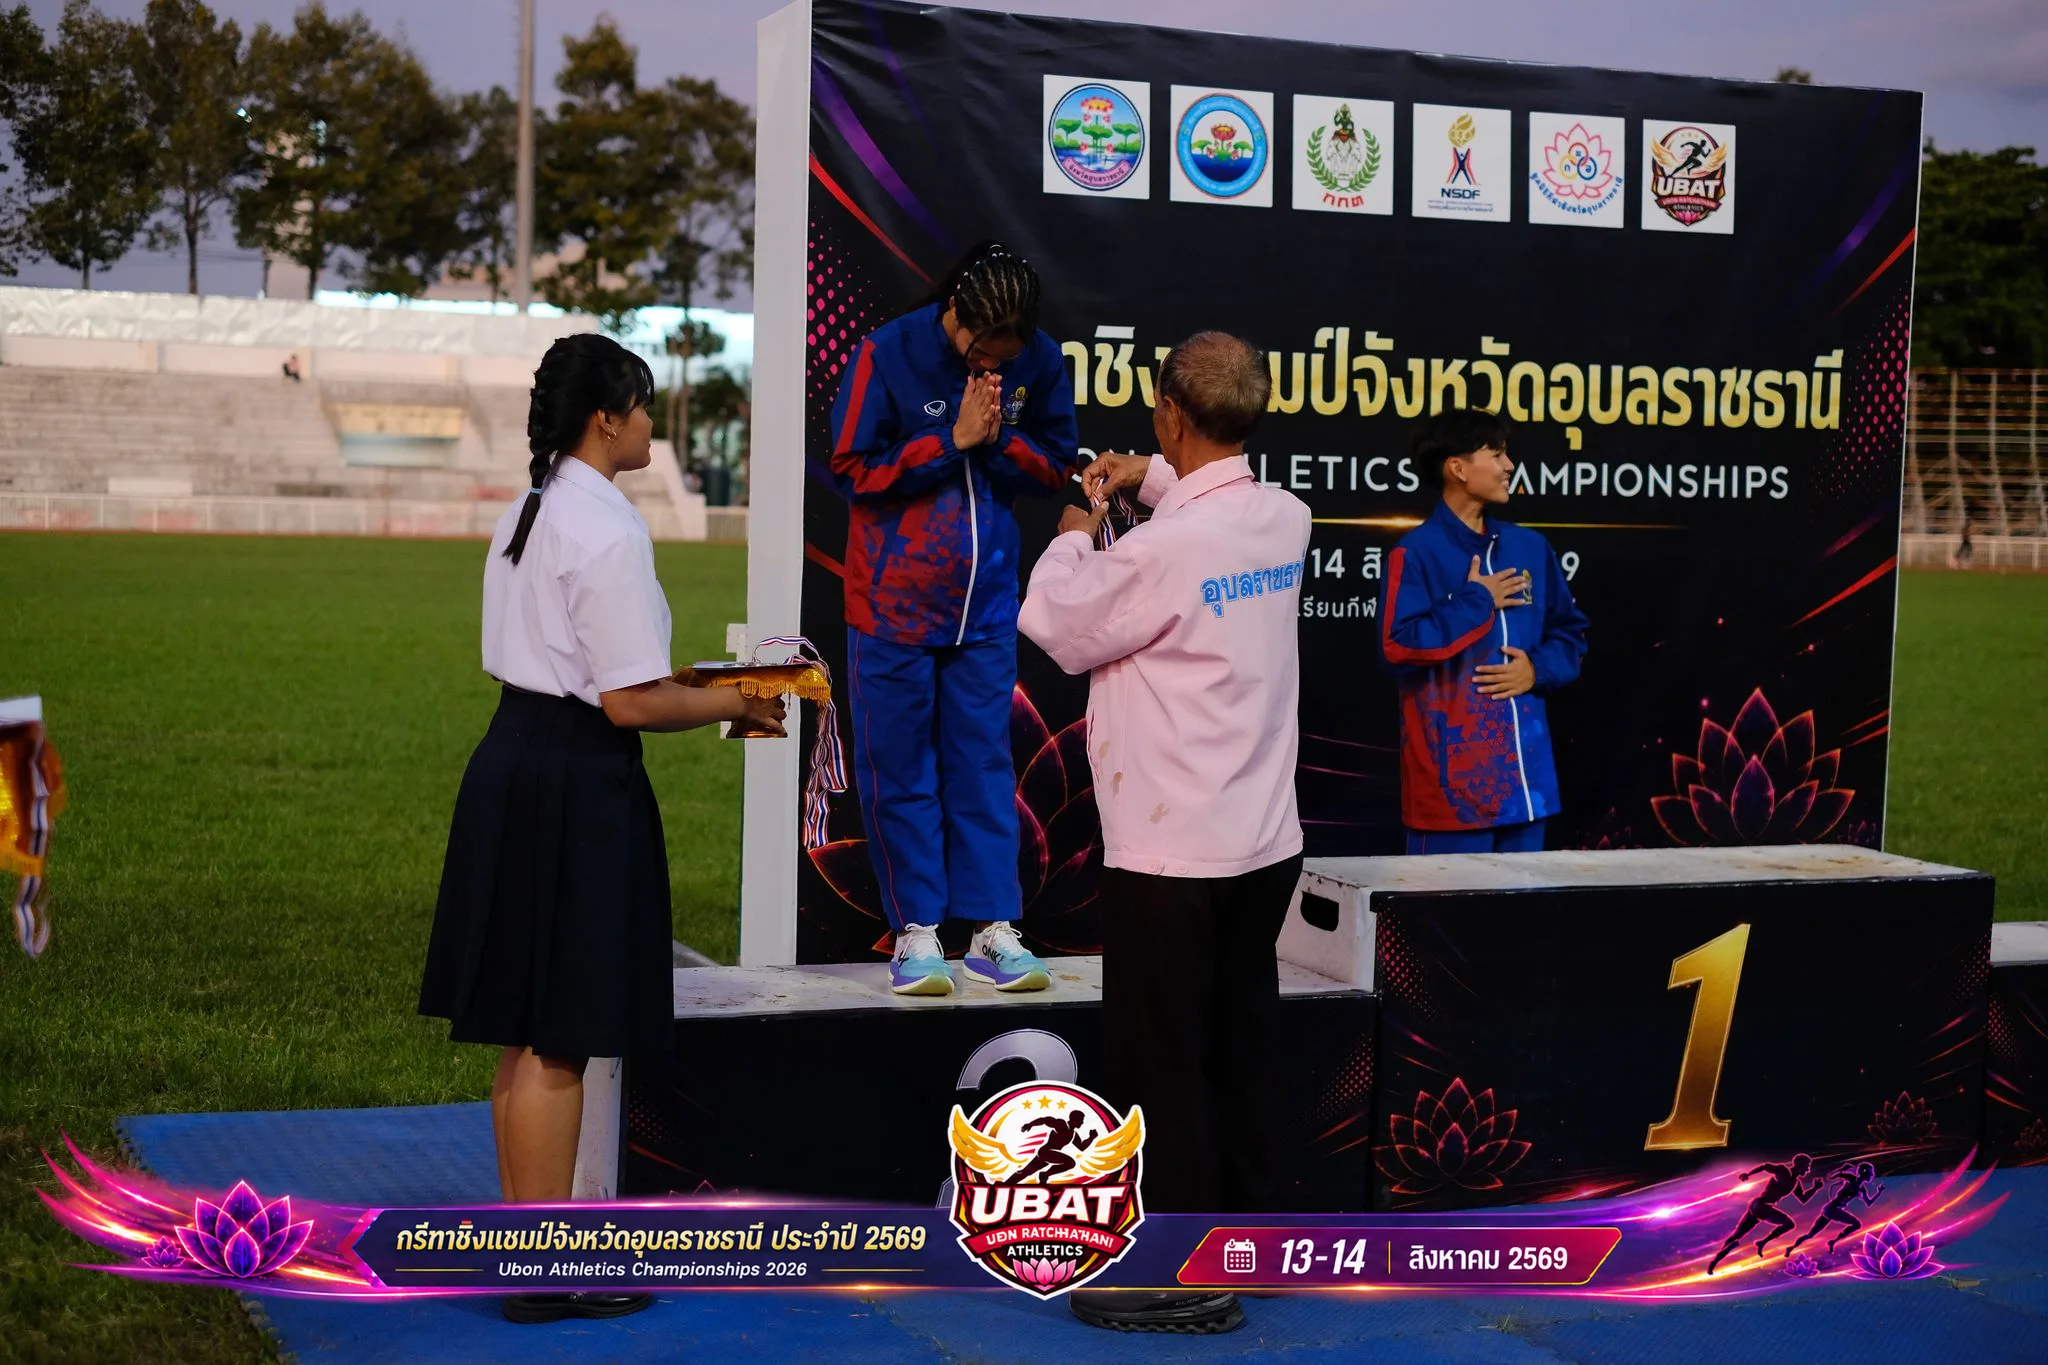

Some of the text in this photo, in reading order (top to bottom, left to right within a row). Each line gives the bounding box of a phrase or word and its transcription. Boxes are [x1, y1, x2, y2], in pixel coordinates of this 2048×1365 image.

[1441, 187, 1481, 199] NSDF
[1656, 176, 1721, 199] UBAT
[1244, 453, 1789, 499] LETICS AMPIONSHIPS
[1644, 923, 1751, 1151] 1
